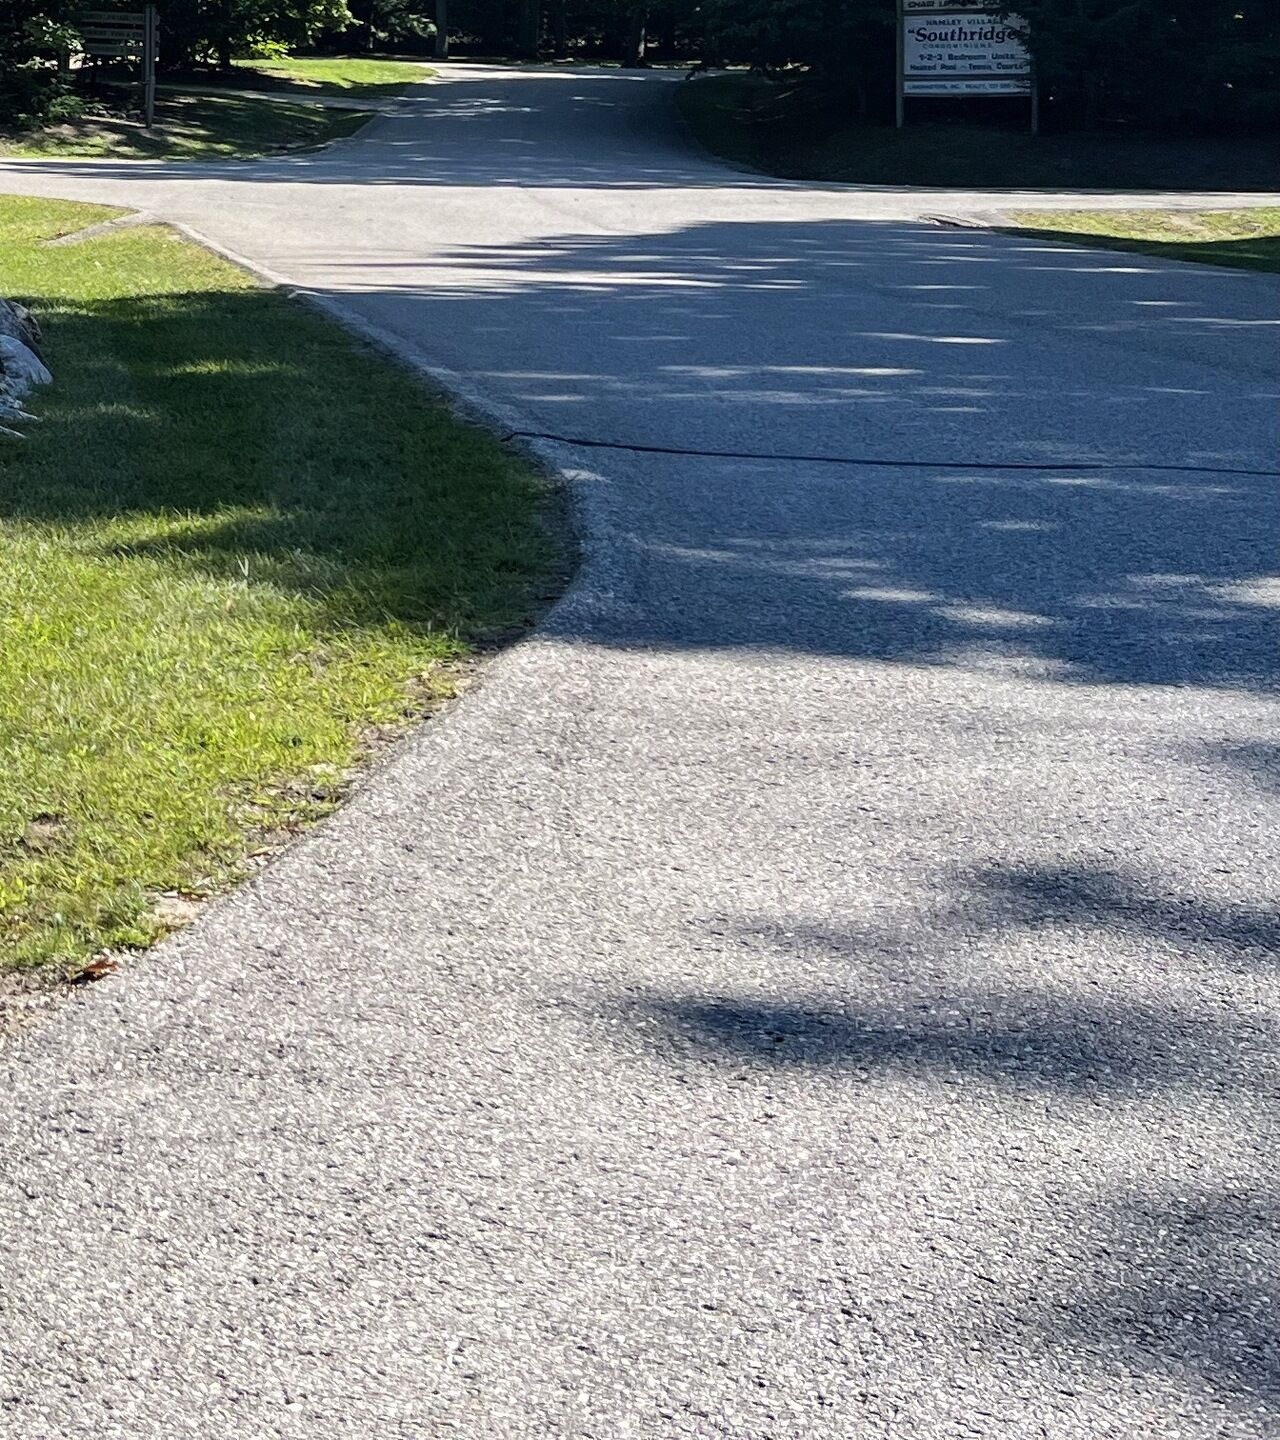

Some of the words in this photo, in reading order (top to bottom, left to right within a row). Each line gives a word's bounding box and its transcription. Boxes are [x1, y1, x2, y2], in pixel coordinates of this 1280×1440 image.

[947, 53, 987, 61] Bedroom
[991, 52, 1015, 60] Units
[940, 63, 957, 71] Pool
